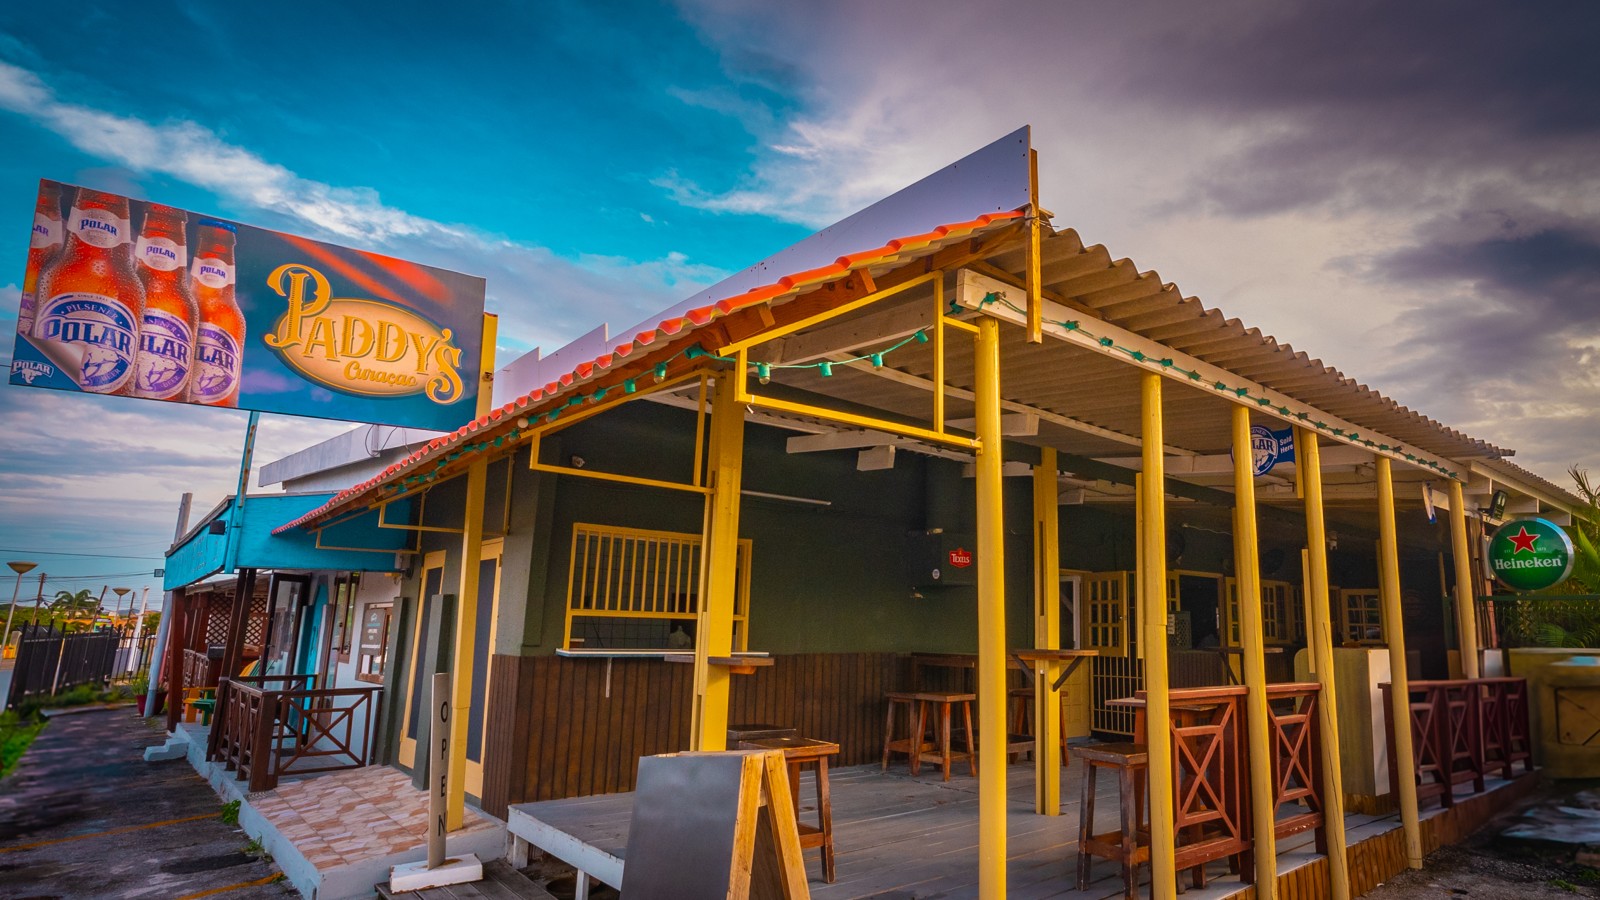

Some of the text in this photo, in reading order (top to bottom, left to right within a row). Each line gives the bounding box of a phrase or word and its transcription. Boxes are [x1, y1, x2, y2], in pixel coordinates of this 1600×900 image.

[80, 218, 118, 236] POLAR
[146, 245, 176, 260] POLAR
[200, 265, 226, 279] POLAR
[66, 303, 118, 320] PILSENER
[44, 319, 131, 356] POLAR
[264, 263, 464, 404] PADDY'S
[140, 334, 187, 364] LAR
[12, 361, 51, 374] POLAR
[195, 345, 234, 373] LAR
[344, 360, 418, 387] Curaçao
[1252, 439, 1274, 452] LAR
[1280, 435, 1292, 446] Sold
[1280, 444, 1294, 454] Here
[1495, 556, 1563, 570] Heineken
[437, 701, 448, 837] OPEN
